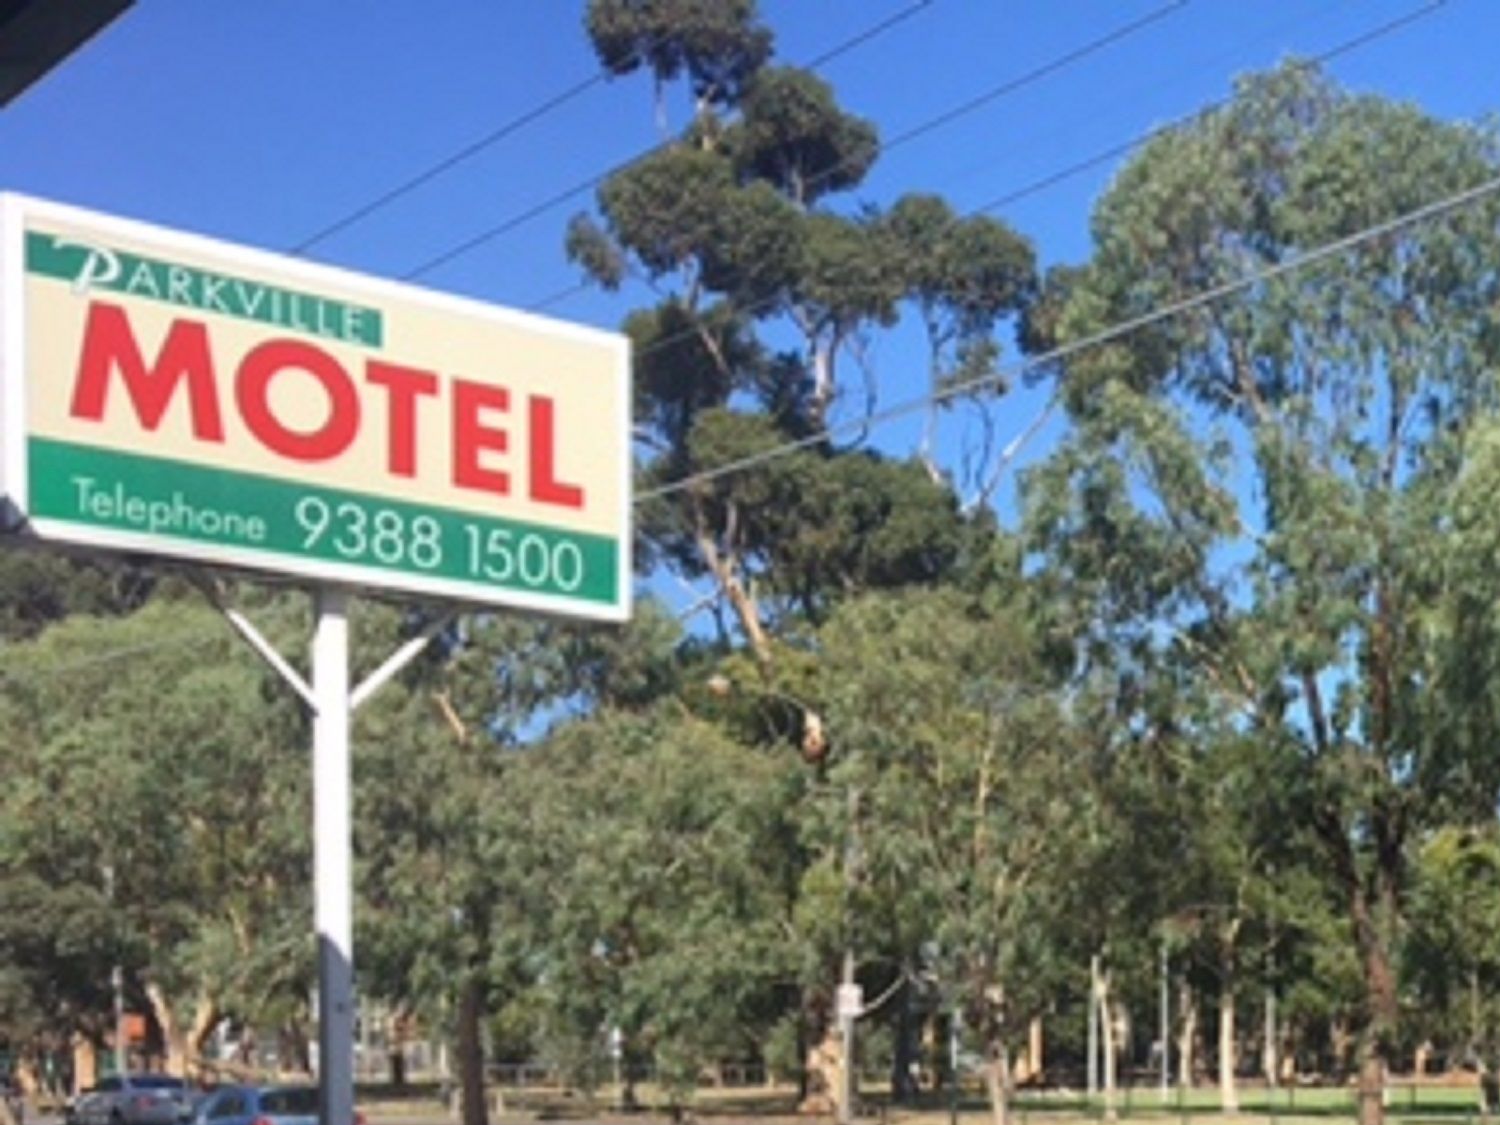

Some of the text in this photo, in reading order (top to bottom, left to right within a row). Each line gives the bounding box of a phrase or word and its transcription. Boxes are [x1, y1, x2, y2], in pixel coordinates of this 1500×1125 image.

[53, 241, 367, 344] PARKVILLE
[69, 300, 584, 509] MOTEL
[71, 475, 583, 592] Telephone 9388 1500
